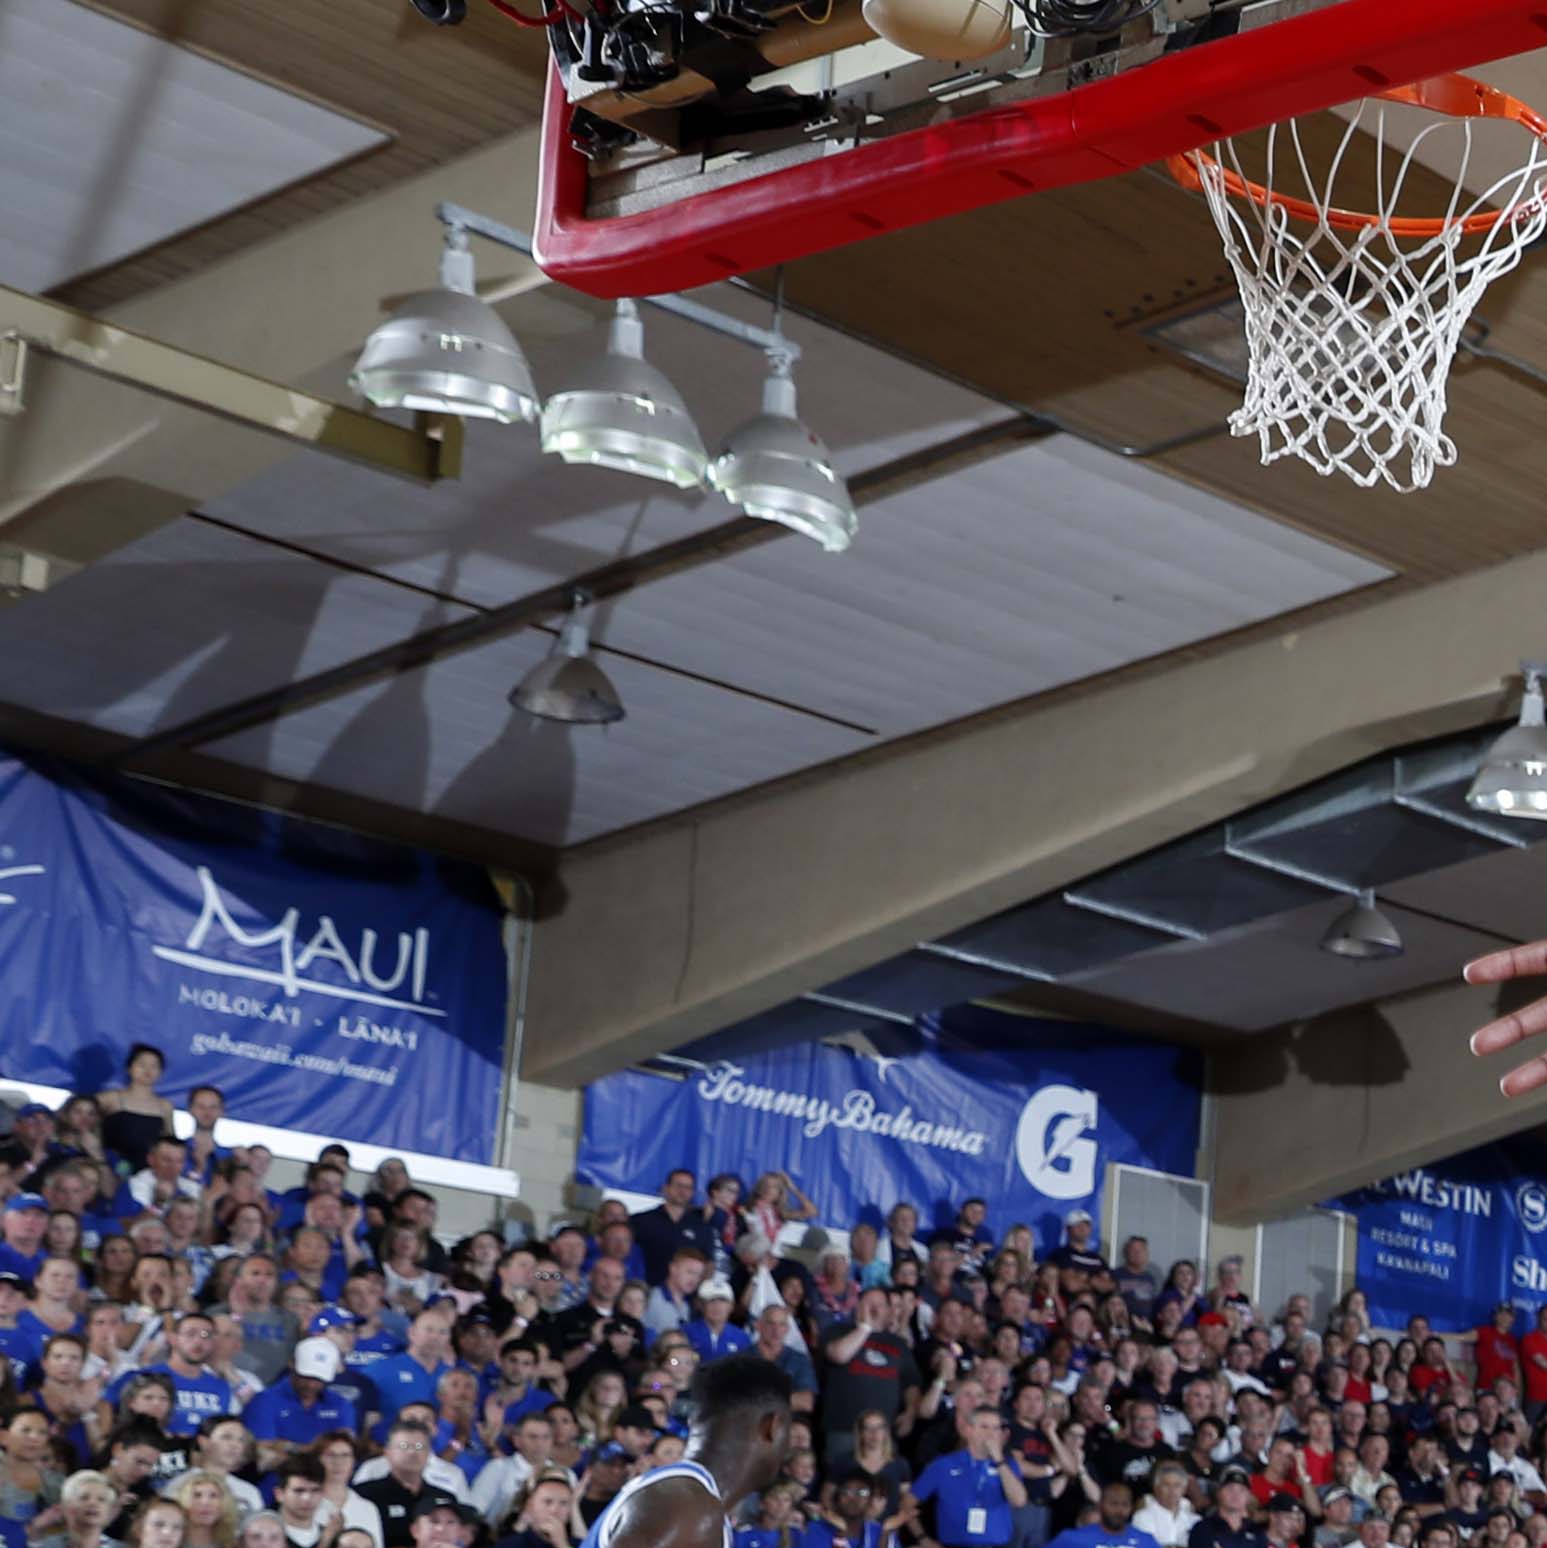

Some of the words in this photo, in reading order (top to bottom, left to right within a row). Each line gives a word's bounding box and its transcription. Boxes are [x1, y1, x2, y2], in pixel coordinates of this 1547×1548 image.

[186, 865, 430, 1002] MAUI
[699, 1060, 836, 1138] Tommy
[830, 1088, 988, 1157] Bahama
[1016, 1084, 1098, 1200] G
[1394, 1170, 1492, 1217] WESTIN
